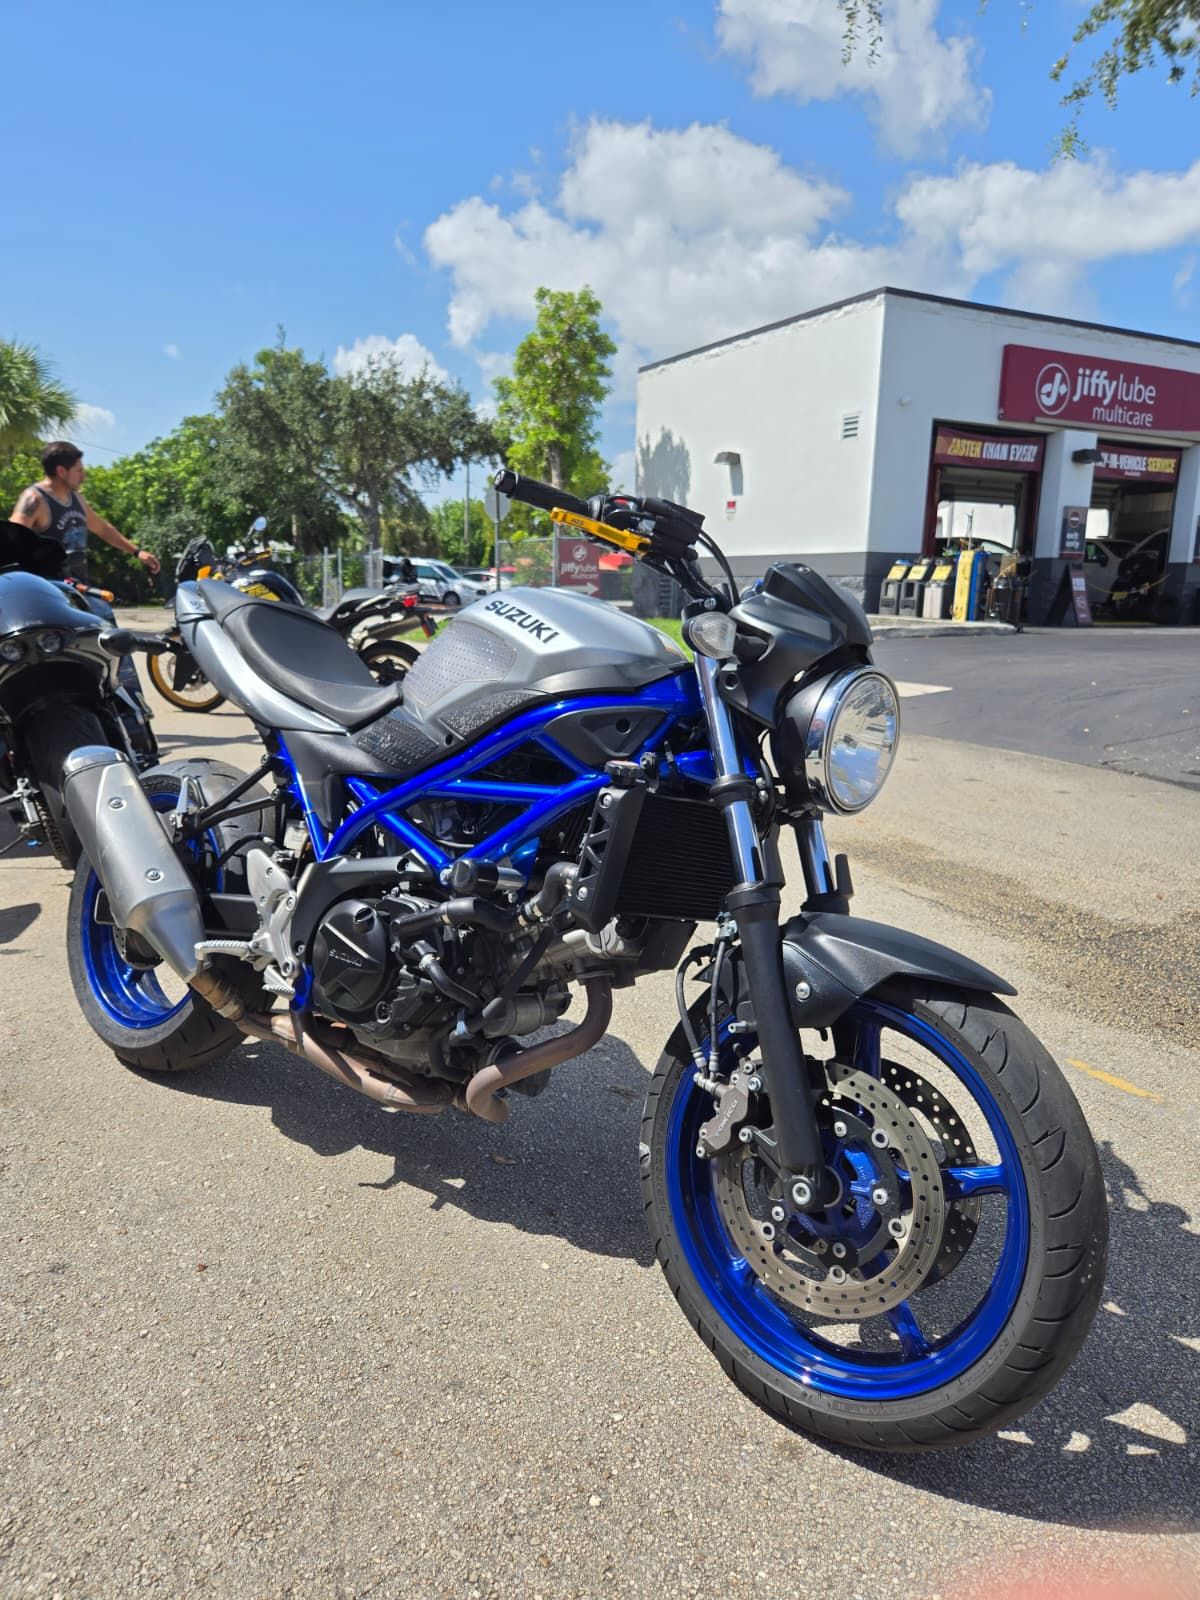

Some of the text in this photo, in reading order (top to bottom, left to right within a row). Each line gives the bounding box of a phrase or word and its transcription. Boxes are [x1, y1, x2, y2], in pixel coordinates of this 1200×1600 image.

[1073, 368, 1156, 406] jiffy lube
[1092, 404, 1153, 427] multicare
[1147, 456, 1176, 473] SERVICE
[560, 562, 579, 575] jiffy
[485, 600, 560, 644] SUZUKI
